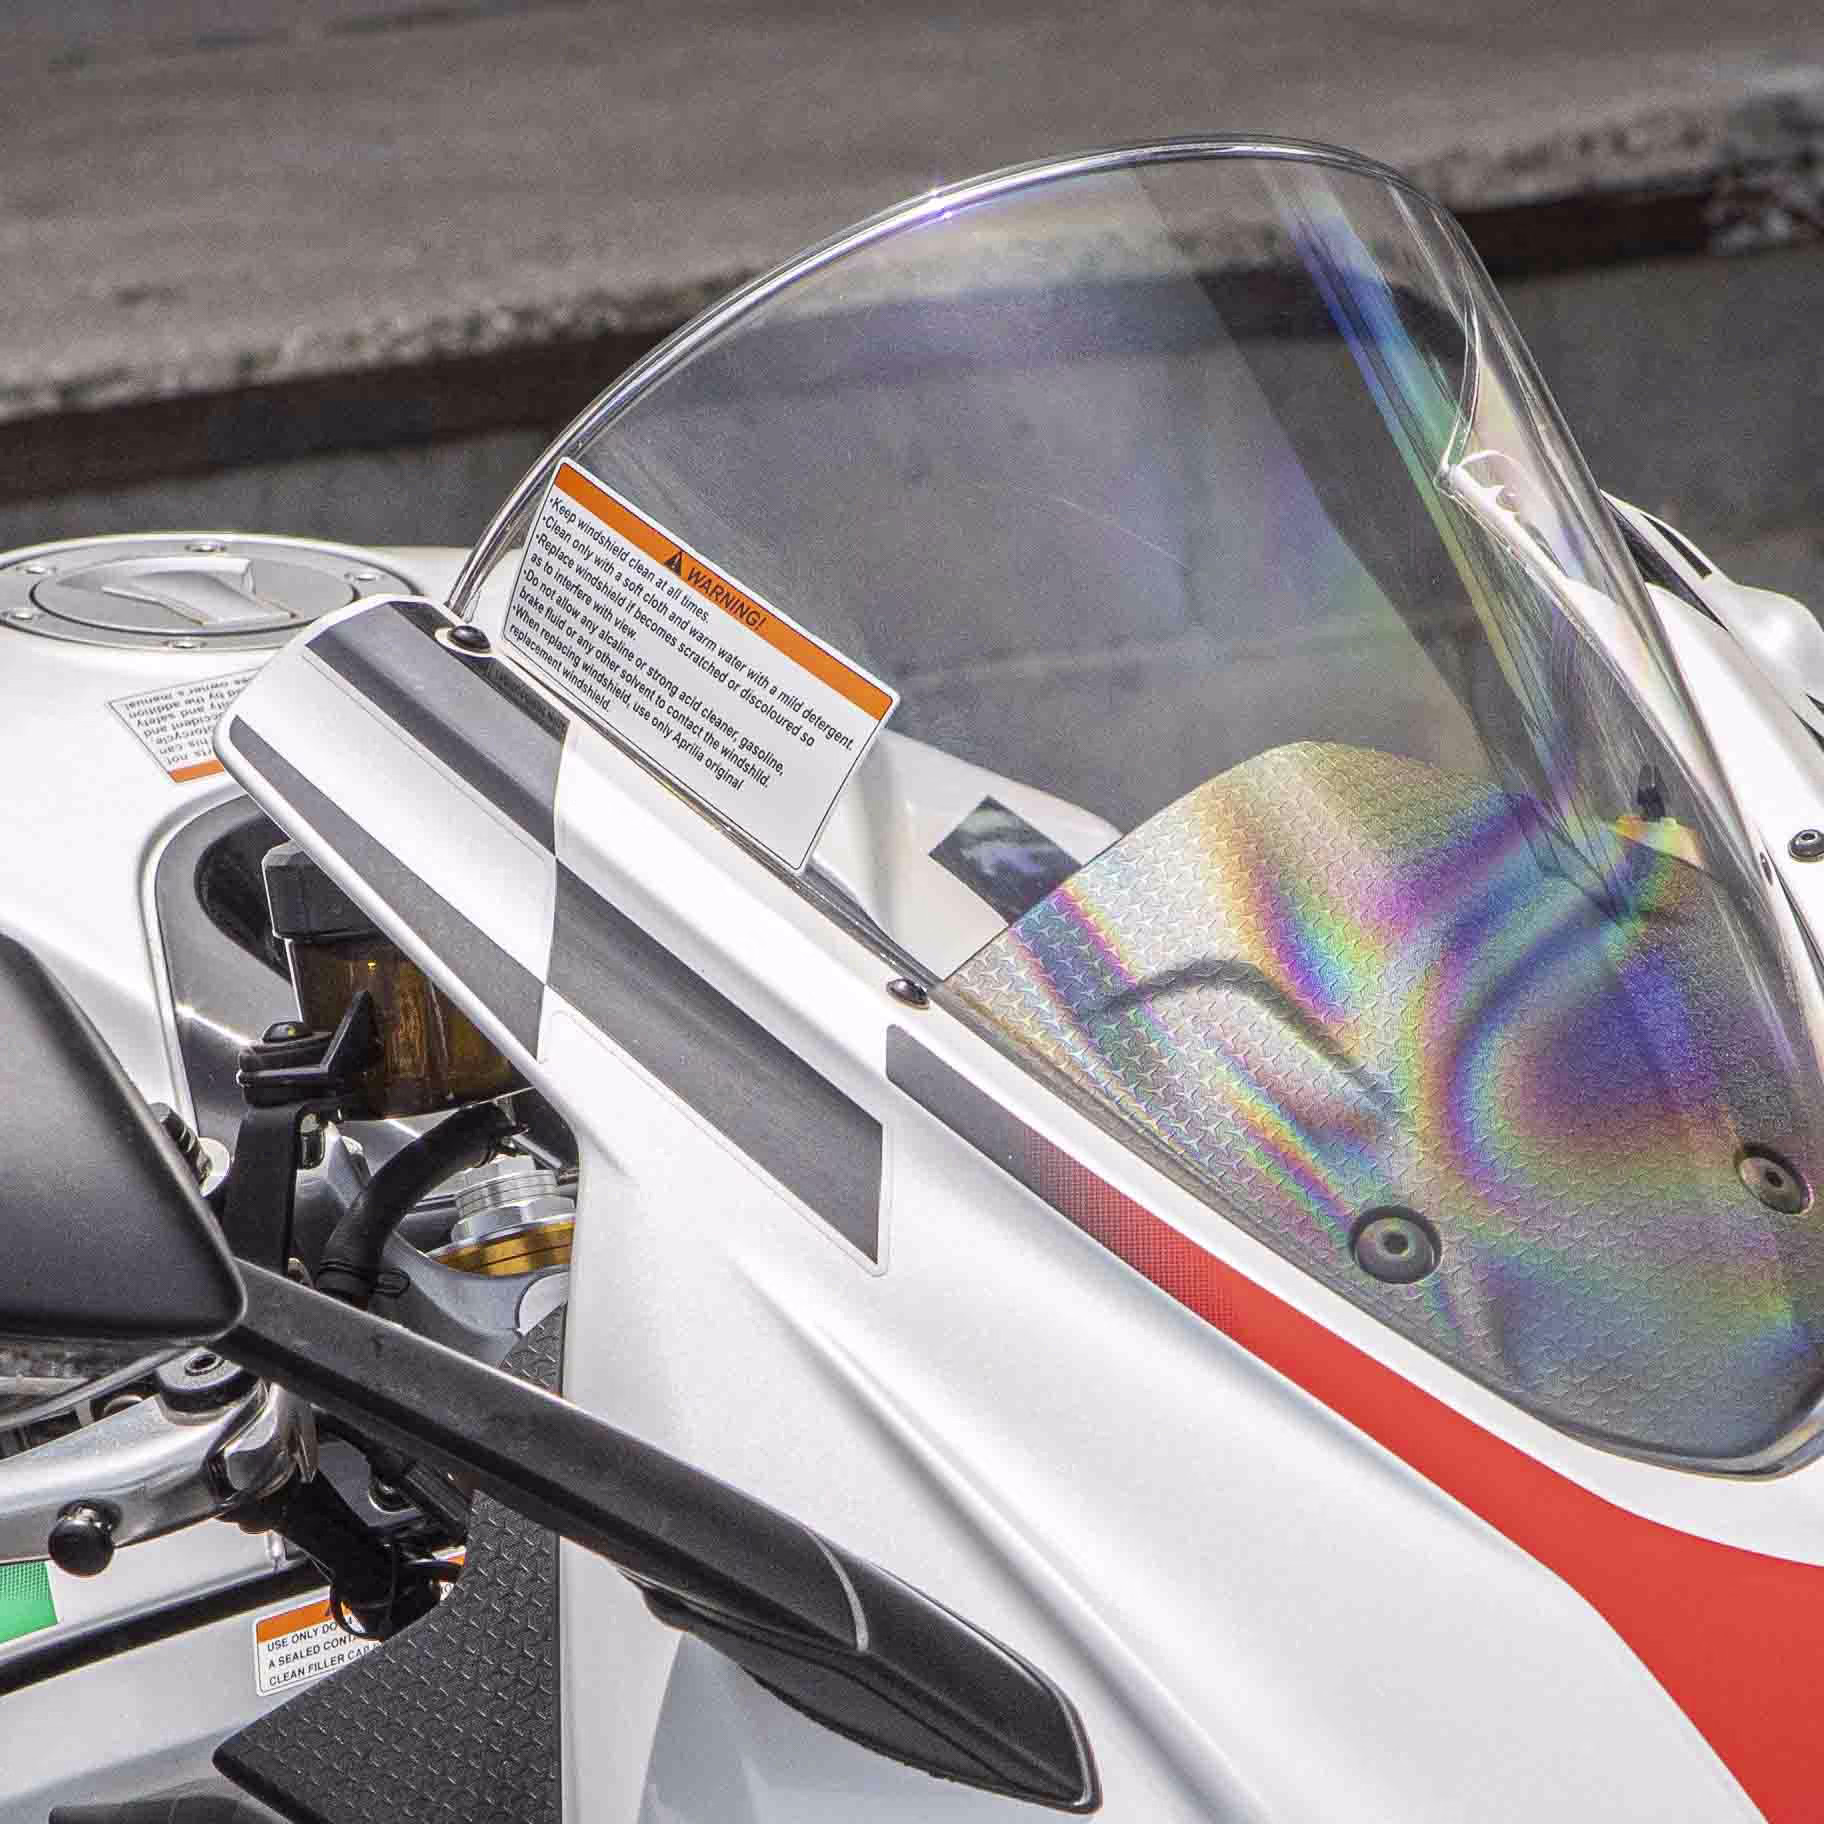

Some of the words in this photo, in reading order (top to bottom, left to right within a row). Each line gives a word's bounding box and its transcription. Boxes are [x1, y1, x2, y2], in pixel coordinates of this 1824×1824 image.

[531, 552, 542, 567] as
[544, 560, 553, 575] to
[554, 567, 592, 605] interfere
[593, 600, 613, 622] with
[614, 616, 637, 640] view.
[578, 517, 630, 562] windshield
[629, 557, 655, 582] clean
[655, 577, 668, 591] at
[667, 585, 682, 600] all
[680, 594, 709, 624] times.
[687, 566, 767, 632] WARNING!
[510, 623, 562, 672] replacement
[563, 665, 611, 712] windshield.
[519, 585, 544, 614] brake
[545, 606, 567, 630] fluid
[566, 625, 577, 639] or
[577, 634, 596, 655] any
[595, 648, 621, 672] other
[620, 668, 656, 701] solvent
[655, 694, 666, 709] to
[666, 704, 704, 738] contact
[703, 730, 720, 750] the
[539, 581, 556, 600] not
[556, 595, 581, 619] allow
[580, 614, 599, 635] any
[598, 628, 634, 662] alcaline
[635, 657, 647, 670] or
[646, 665, 679, 697] strong
[679, 690, 703, 712] acid
[701, 707, 739, 742] cleaner,
[738, 736, 783, 776] gasoline,
[572, 538, 594, 560] only
[594, 554, 614, 576] with
[615, 571, 622, 582] a
[622, 577, 644, 597] soft
[643, 592, 668, 616] cloth
[668, 610, 691, 631] and
[689, 625, 717, 652] warm
[718, 647, 747, 672] water
[747, 667, 770, 689] with
[769, 684, 778, 695] a
[777, 690, 805, 712] mild
[802, 707, 854, 751] detergent.
[576, 563, 627, 607] windshield
[625, 599, 636, 614] if
[633, 606, 677, 647] becomes
[677, 641, 729, 683] scratched
[728, 679, 741, 692] or
[740, 687, 803, 736] discoloured
[800, 731, 815, 746] so
[540, 627, 581, 668] replacing
[582, 660, 631, 709] windshield,
[633, 701, 650, 720] use
[651, 716, 674, 739] only
[672, 731, 704, 762] Aprilia
[705, 757, 744, 791] original
[267, 1636, 289, 1653] USE
[291, 1627, 319, 1645] ONLY
[269, 1667, 306, 1687] CLEAN
[308, 1653, 345, 1674] FILLER
[278, 1644, 321, 1667] SEALED
